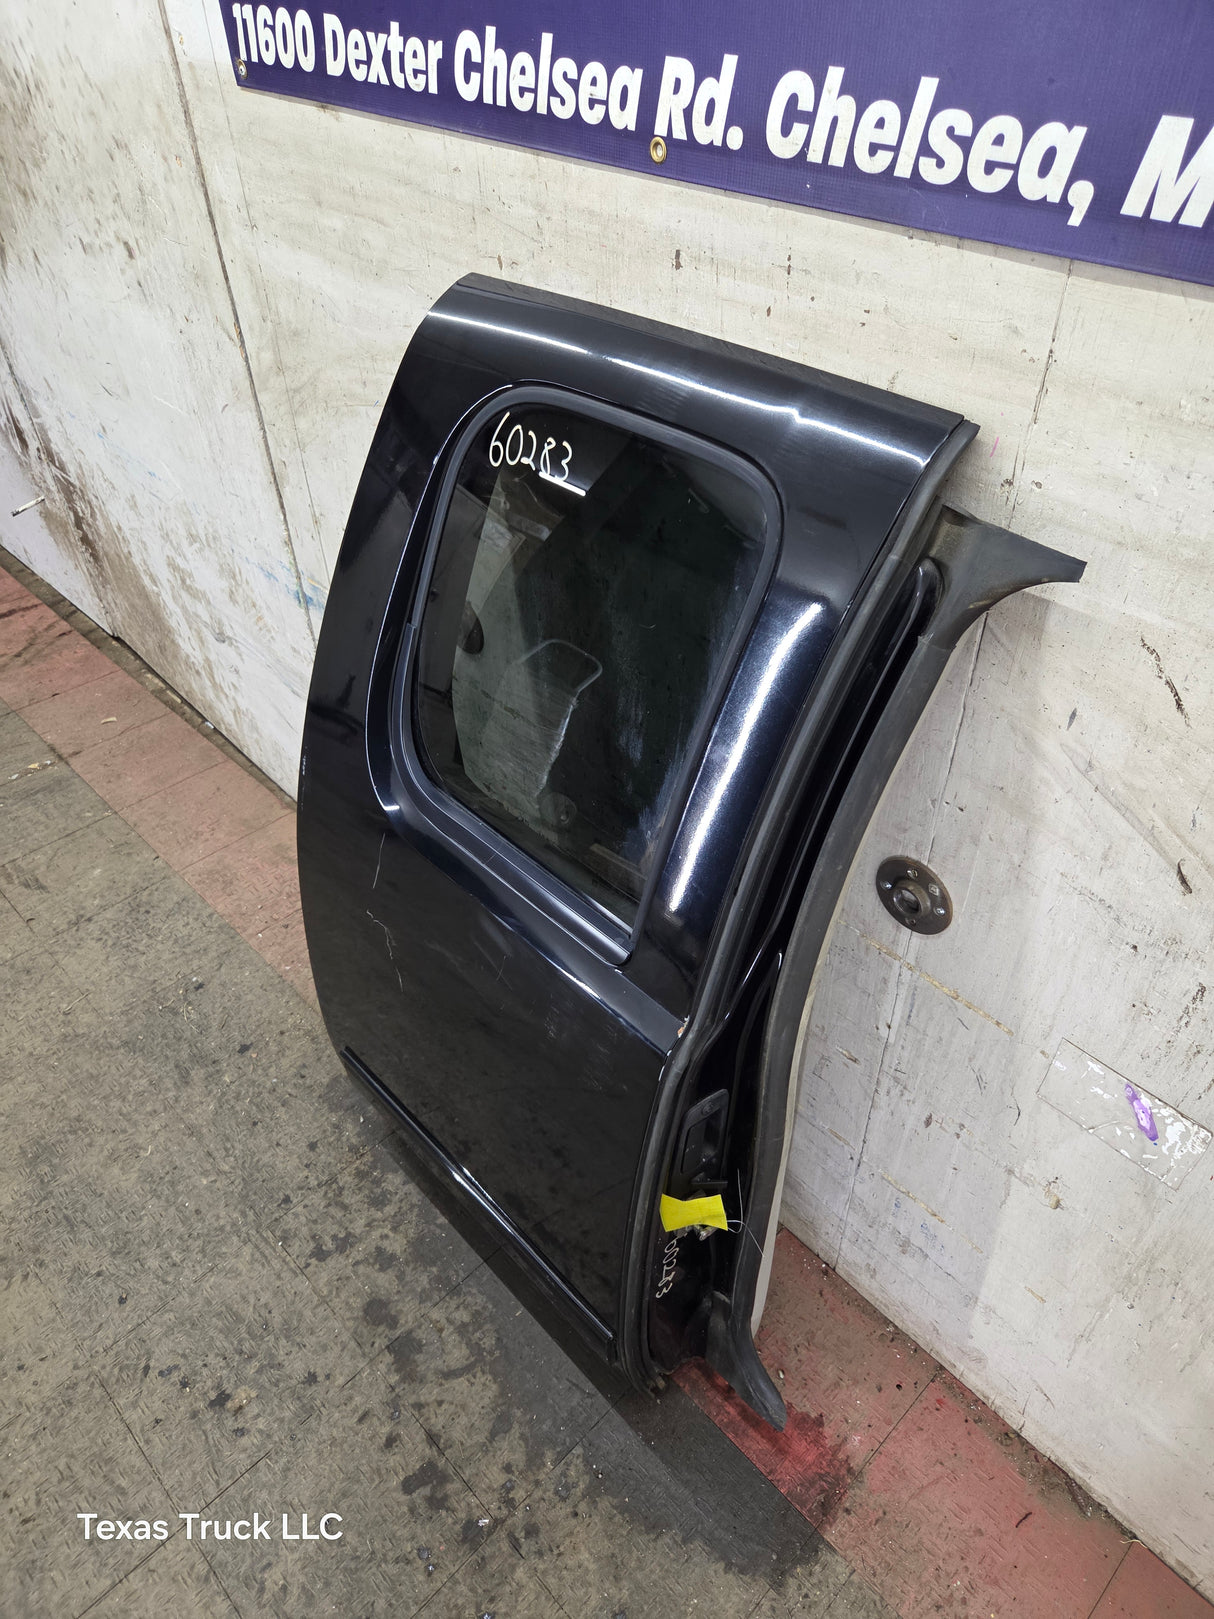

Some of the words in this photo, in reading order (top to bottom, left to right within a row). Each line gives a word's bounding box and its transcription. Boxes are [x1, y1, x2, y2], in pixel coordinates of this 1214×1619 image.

[232, 2, 316, 73] 11600
[323, 13, 443, 95] Dexter
[454, 26, 644, 132] Chelsea
[653, 53, 744, 151] Rd.
[765, 66, 1095, 227] Chelsea,
[489, 411, 573, 482] 60283
